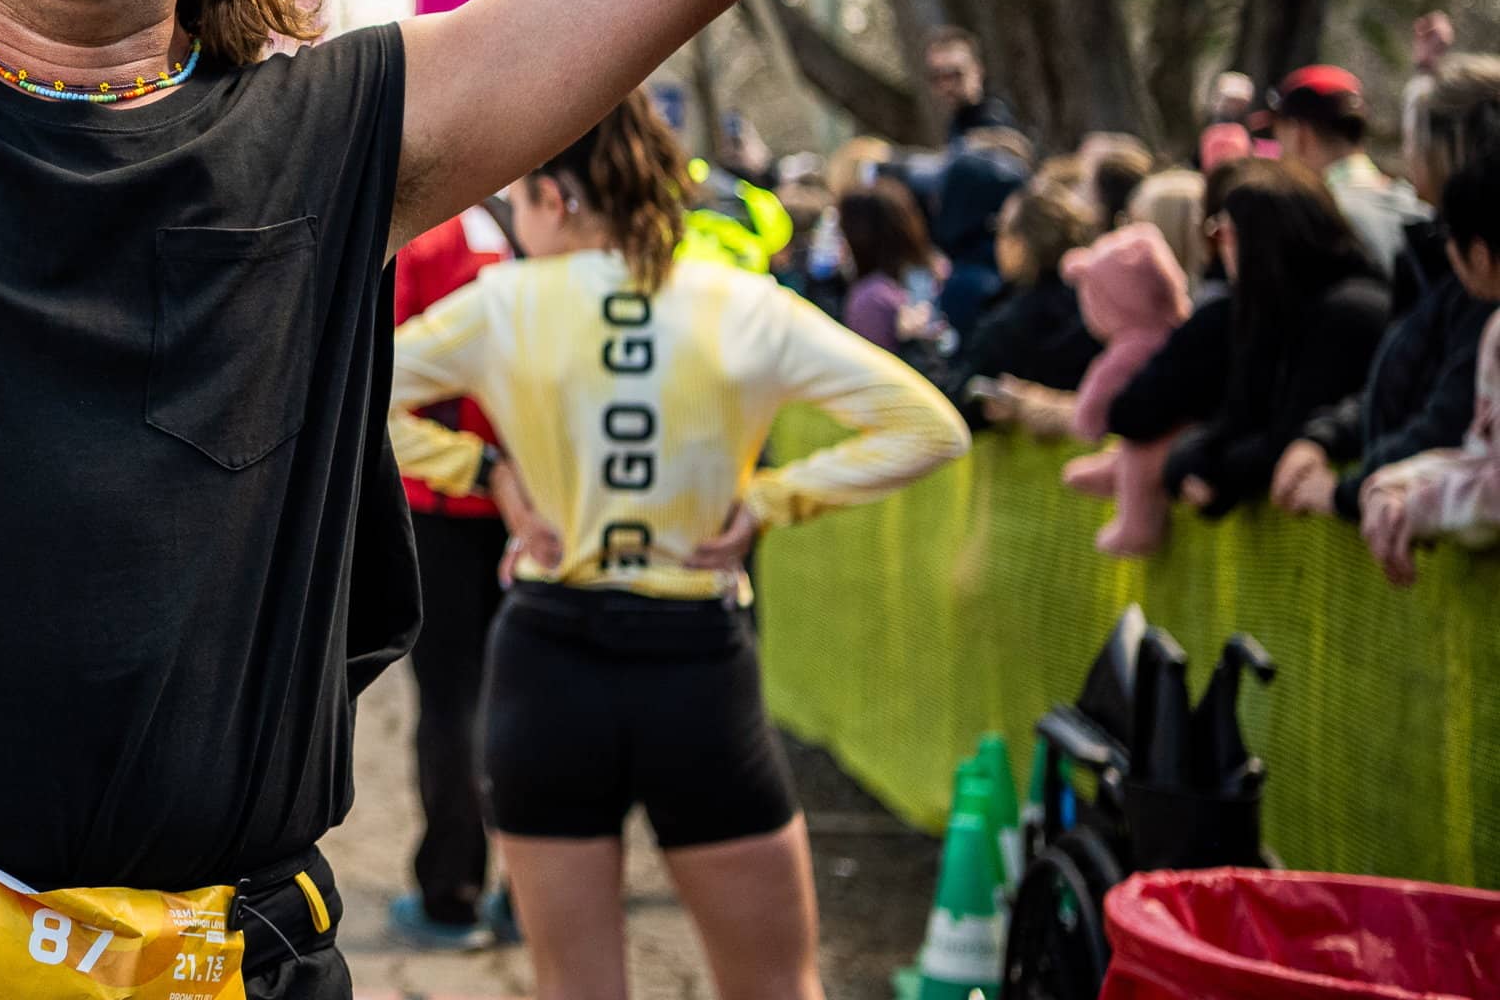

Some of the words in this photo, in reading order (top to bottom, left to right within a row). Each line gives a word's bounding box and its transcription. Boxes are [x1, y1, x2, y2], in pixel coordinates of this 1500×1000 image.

[601, 292, 654, 375] GO
[601, 404, 656, 490] GO
[173, 952, 214, 982] 21.1
